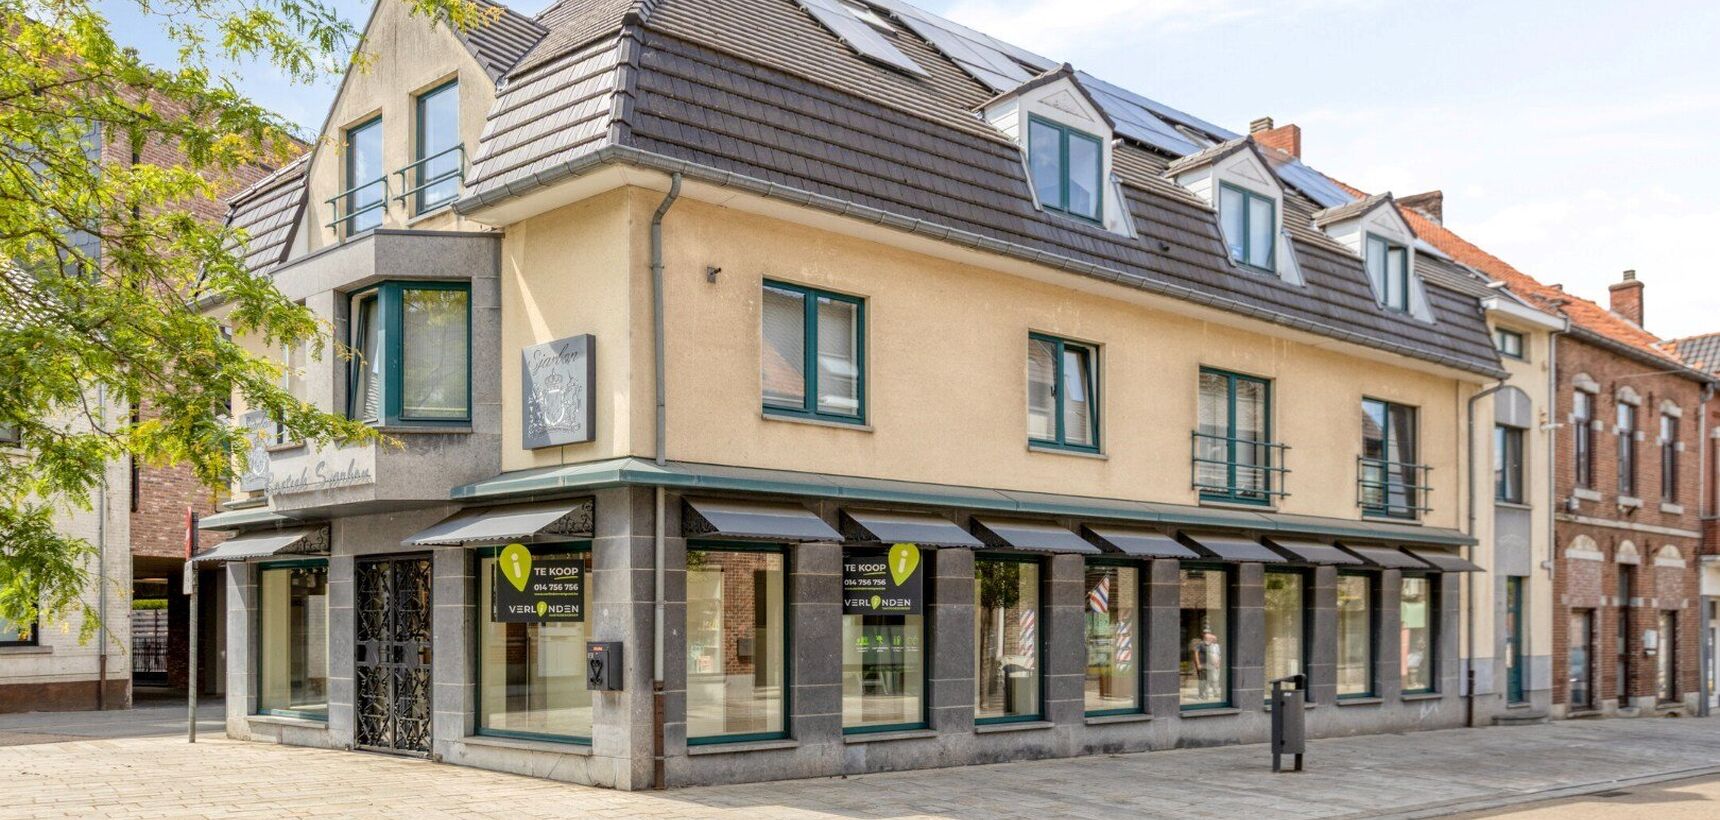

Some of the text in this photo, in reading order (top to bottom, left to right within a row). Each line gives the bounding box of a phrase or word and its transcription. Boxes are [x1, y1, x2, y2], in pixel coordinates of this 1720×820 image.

[534, 567, 579, 576] TE KOOP
[844, 563, 886, 572] TE KOOP
